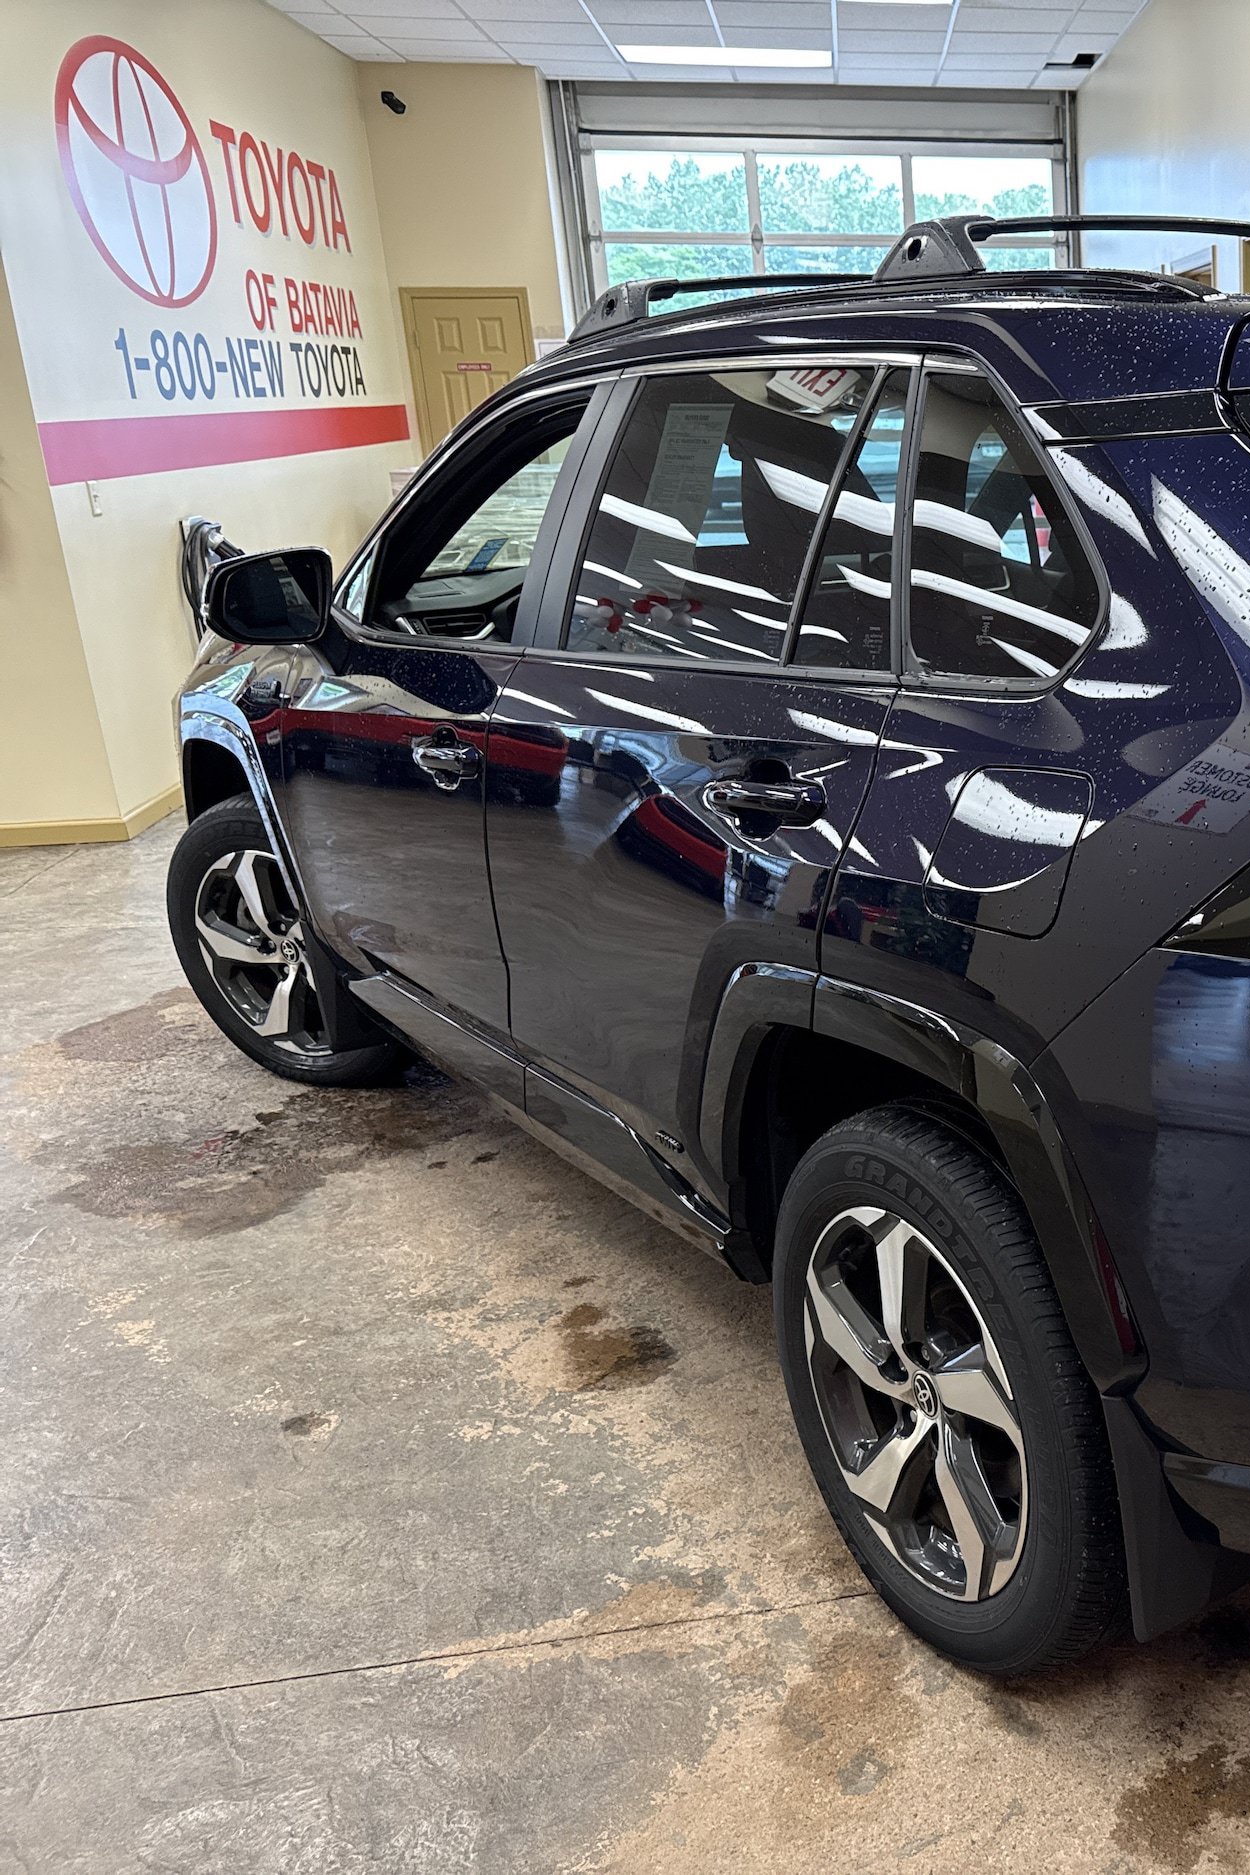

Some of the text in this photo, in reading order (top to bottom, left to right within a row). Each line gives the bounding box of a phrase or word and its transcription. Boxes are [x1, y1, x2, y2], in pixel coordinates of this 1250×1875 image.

[209, 119, 352, 254] TOYOTA
[245, 269, 363, 338] OF BATAVIA
[114, 327, 366, 400] 1-800-NEW TOYOTA
